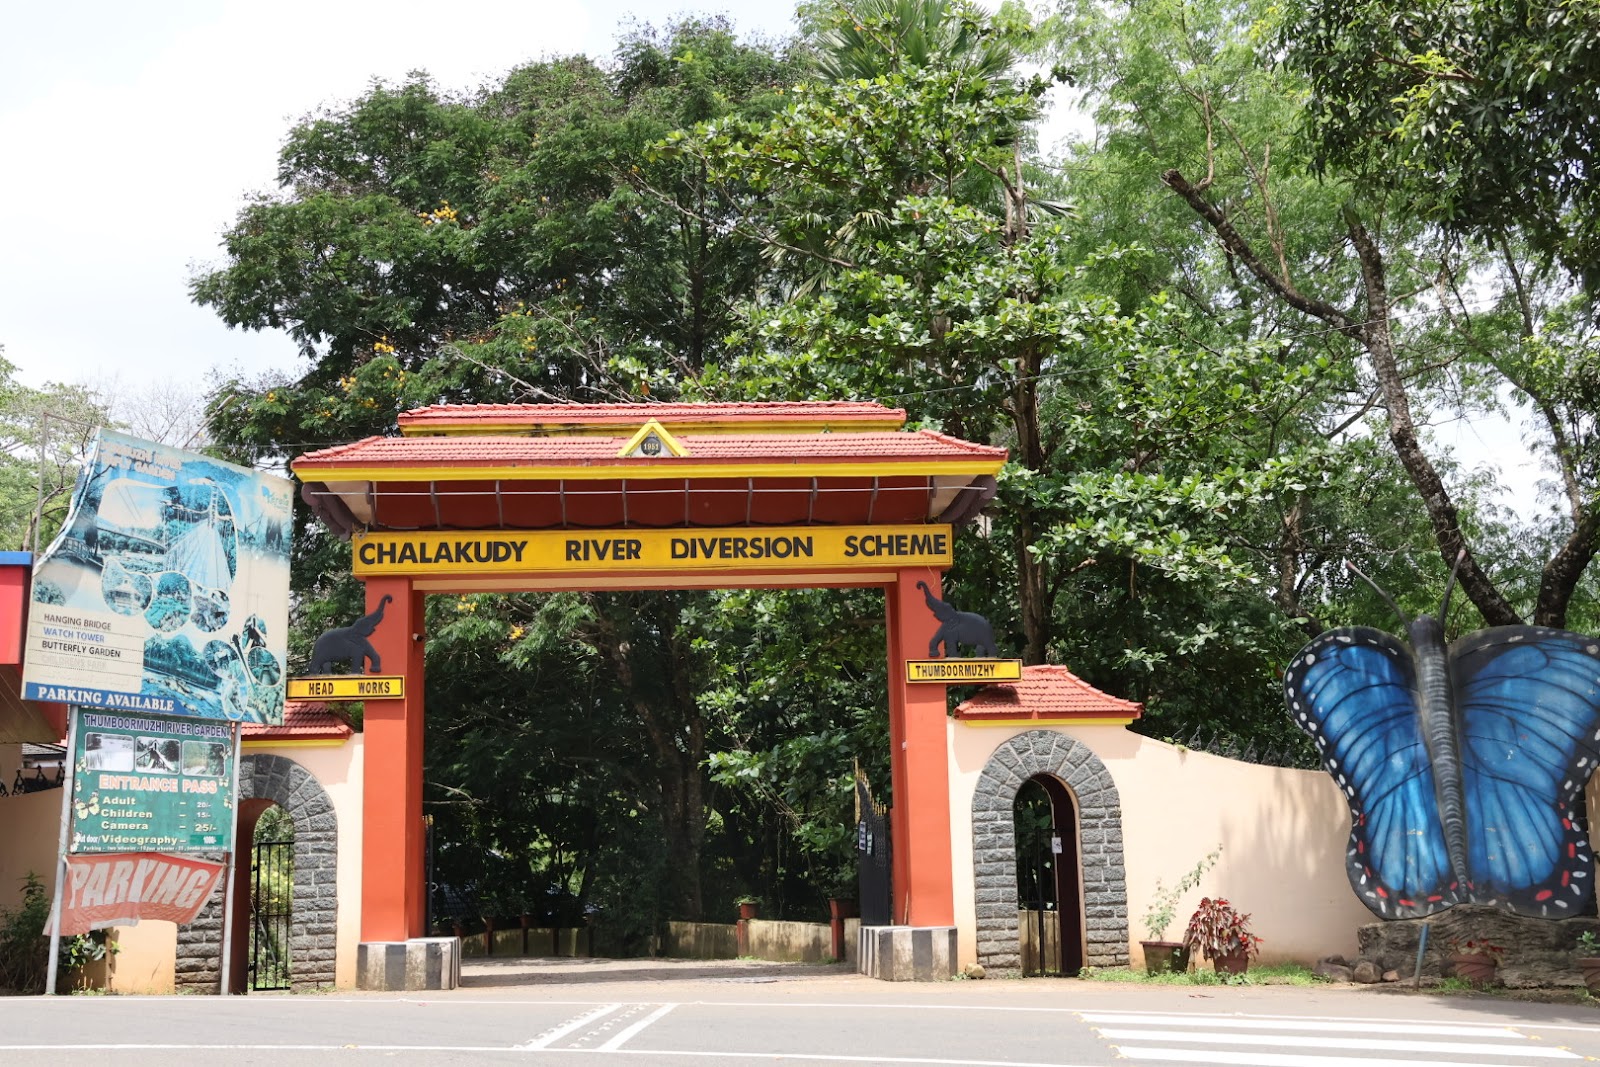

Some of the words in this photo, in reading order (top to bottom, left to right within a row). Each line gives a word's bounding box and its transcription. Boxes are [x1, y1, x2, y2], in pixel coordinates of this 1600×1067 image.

[359, 540, 528, 565] CHALAKUDY
[565, 539, 642, 561] RIVER
[671, 536, 813, 559] DIVERSION
[844, 534, 947, 557] SCHEME
[44, 613, 81, 627] HANGING
[84, 619, 111, 631] BRIDGE
[43, 627, 74, 638] WATCH
[76, 631, 105, 643] TOWER
[42, 640, 87, 654] BUTTERFLY
[89, 646, 121, 658] GARDEN
[915, 664, 996, 678] THUMBOORMUZHY
[308, 682, 334, 695] HEAD
[357, 681, 390, 694] WORKS
[37, 686, 103, 704] PARKING
[105, 694, 175, 712] AVAILABLE
[84, 713, 165, 733] THUMBOORMUZHI
[166, 722, 193, 736] RIVER
[98, 774, 179, 793] ENTRANCE
[182, 778, 218, 795] PASS
[102, 796, 136, 805] Adult
[101, 808, 153, 818] Children
[101, 820, 149, 830] Camera
[194, 823, 217, 832] 25/-
[68, 858, 210, 910] PARKING
